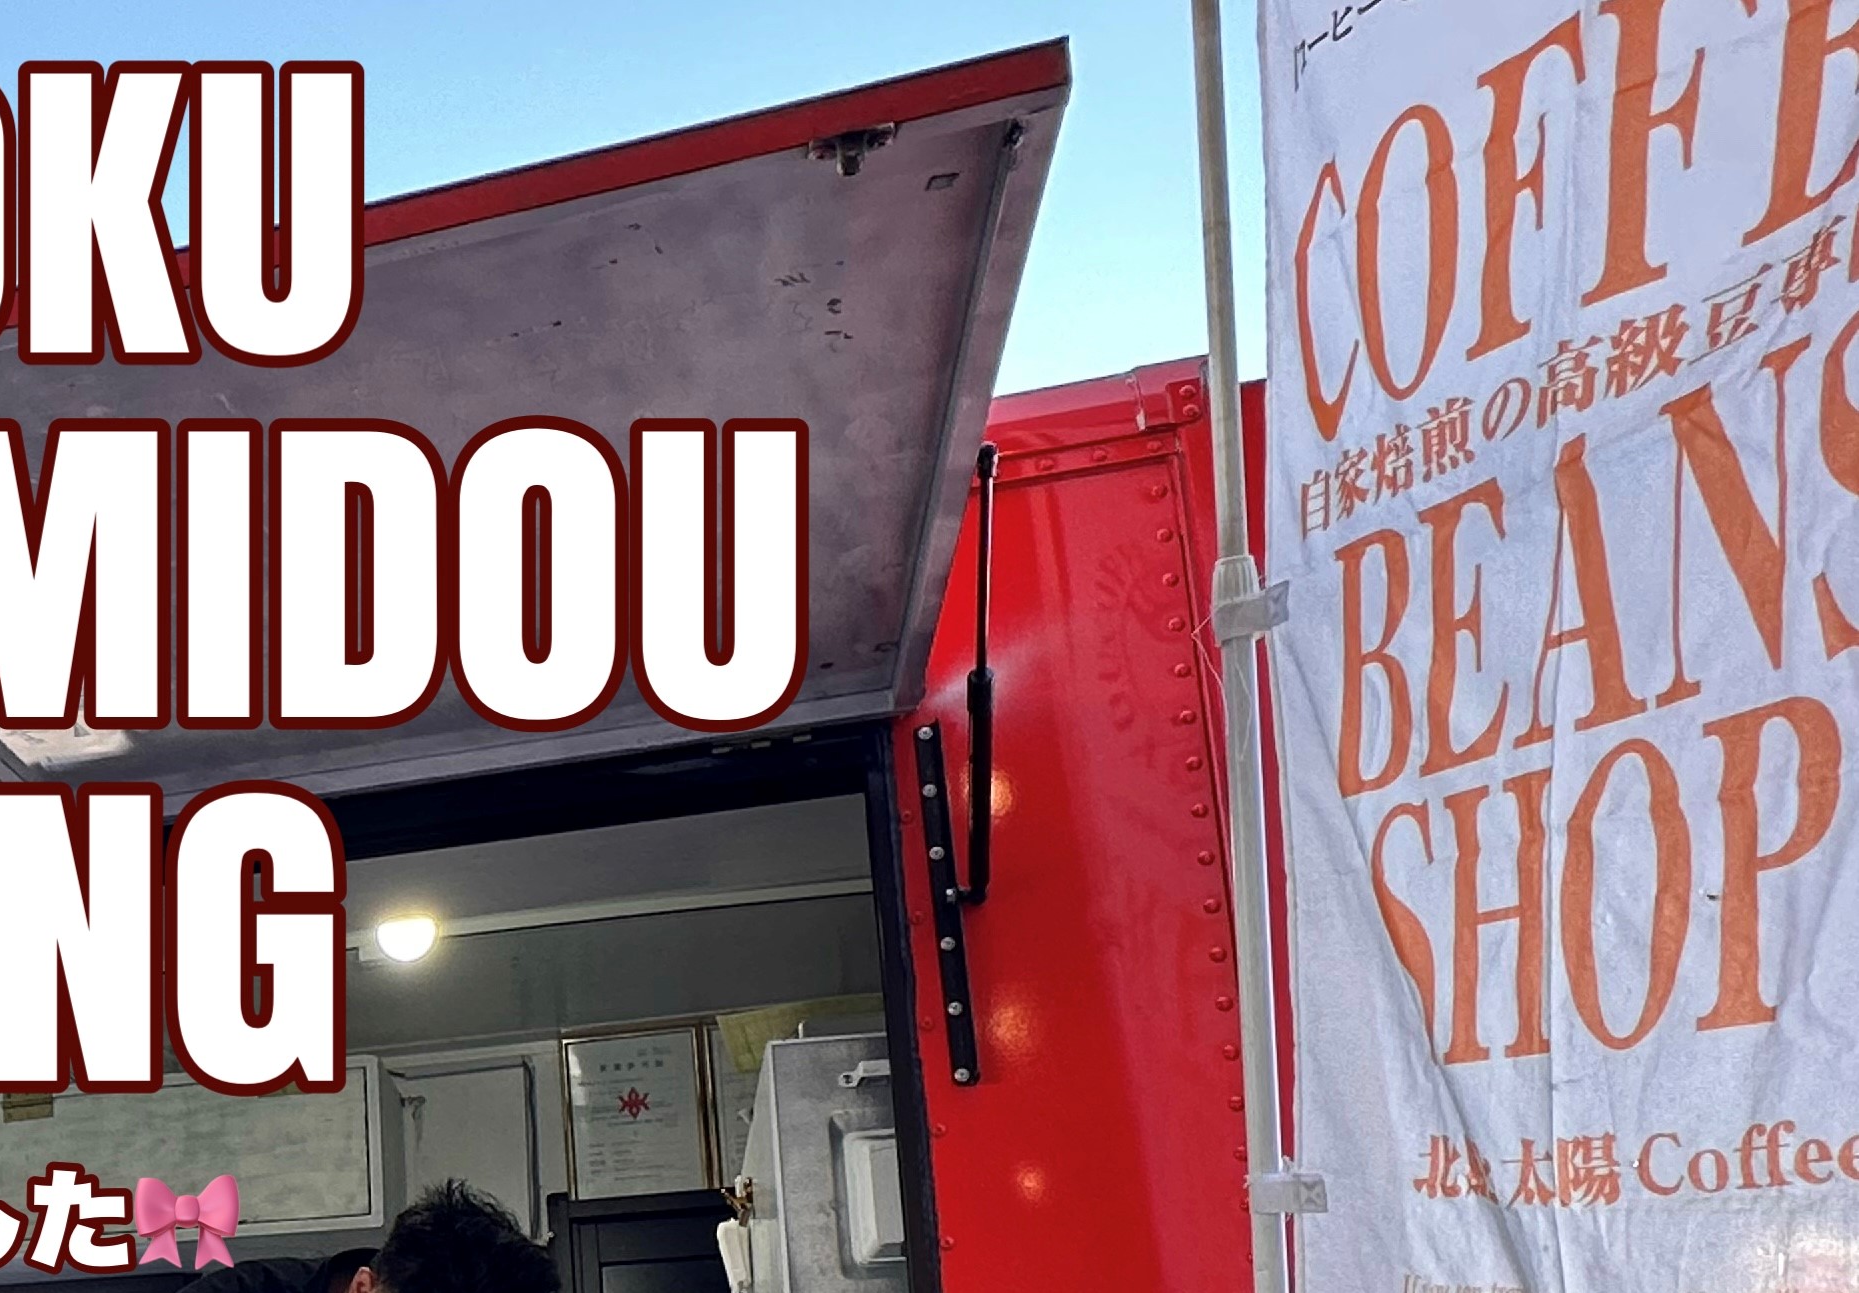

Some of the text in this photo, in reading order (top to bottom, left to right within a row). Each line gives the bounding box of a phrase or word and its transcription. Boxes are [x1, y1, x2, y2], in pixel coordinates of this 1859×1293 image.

[1301, 203, 1859, 540] 自家焙煎の高級豆専
[1370, 696, 1842, 1066] SHOP
[1637, 1119, 1859, 1204] Coffee
